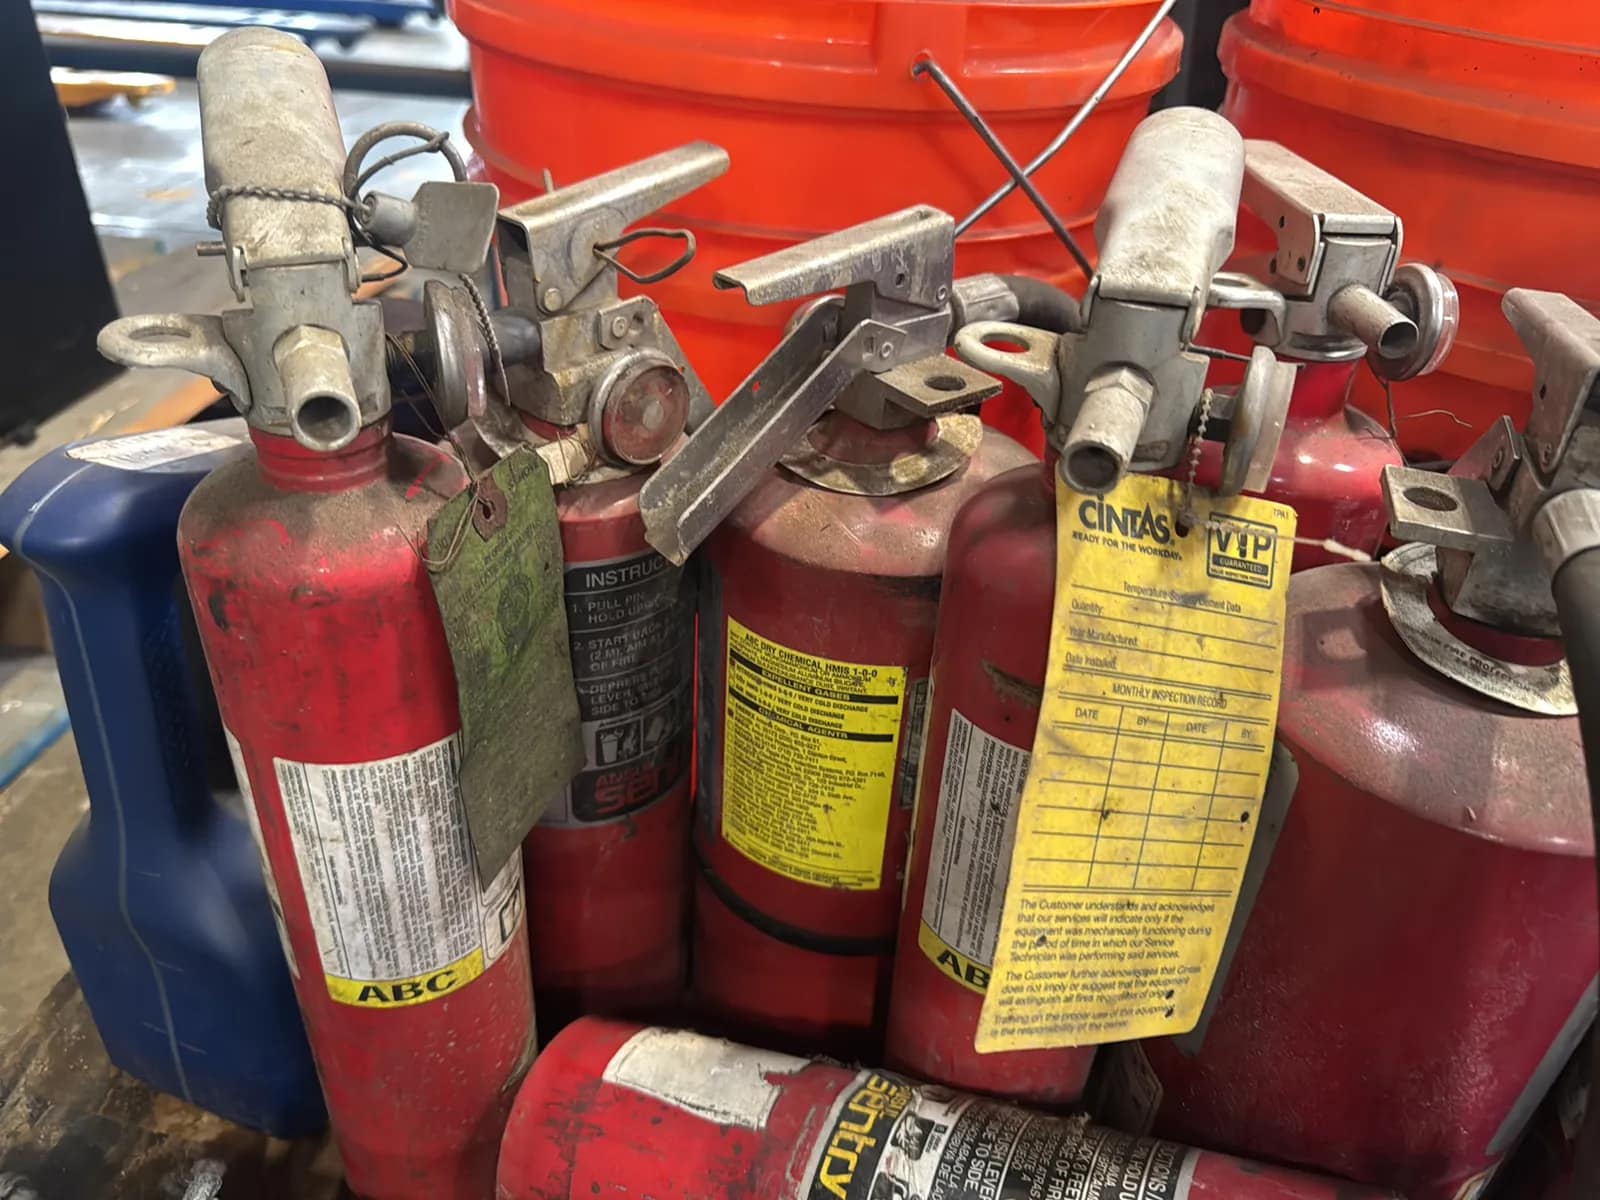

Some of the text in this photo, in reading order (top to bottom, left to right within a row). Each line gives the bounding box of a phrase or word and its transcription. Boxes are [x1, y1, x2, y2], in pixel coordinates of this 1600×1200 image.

[1078, 495, 1171, 544] CINTAS
[1072, 531, 1100, 544] READY
[1102, 537, 1119, 548] FOR
[1121, 541, 1137, 552] THE
[585, 556, 669, 588] INSTRUC
[1123, 581, 1168, 599] Temperature
[588, 597, 621, 612] PULL
[1227, 600, 1242, 613] Data
[588, 609, 625, 624] HOLD
[588, 633, 629, 650] START
[760, 640, 776, 656] DRY
[778, 649, 821, 670] CHEMICAL
[1065, 652, 1083, 665] Date
[761, 668, 810, 693] EXPELLENT
[1112, 682, 1150, 700] MONTHLY
[1151, 689, 1196, 706] INSPECTION
[758, 705, 804, 730] CHMICAL
[1075, 706, 1252, 739] DATE BY DATE BY
[1021, 899, 1037, 909] The
[1039, 899, 1083, 910] Customer
[1141, 902, 1157, 911] and
[1018, 913, 1036, 923] that
[1039, 915, 1052, 923] our
[1055, 914, 1091, 923] services
[1060, 939, 1070, 949] of
[1065, 928, 1083, 937] was
[936, 949, 991, 989] AB
[357, 970, 458, 1004] ABC
[963, 1142, 993, 1193] TO SIDE.
[1055, 1159, 1071, 1178] OF
[1122, 1159, 1144, 1192] HOLD
[1044, 1177, 1065, 1200] FIR
[1063, 1171, 1085, 1200] FEE
